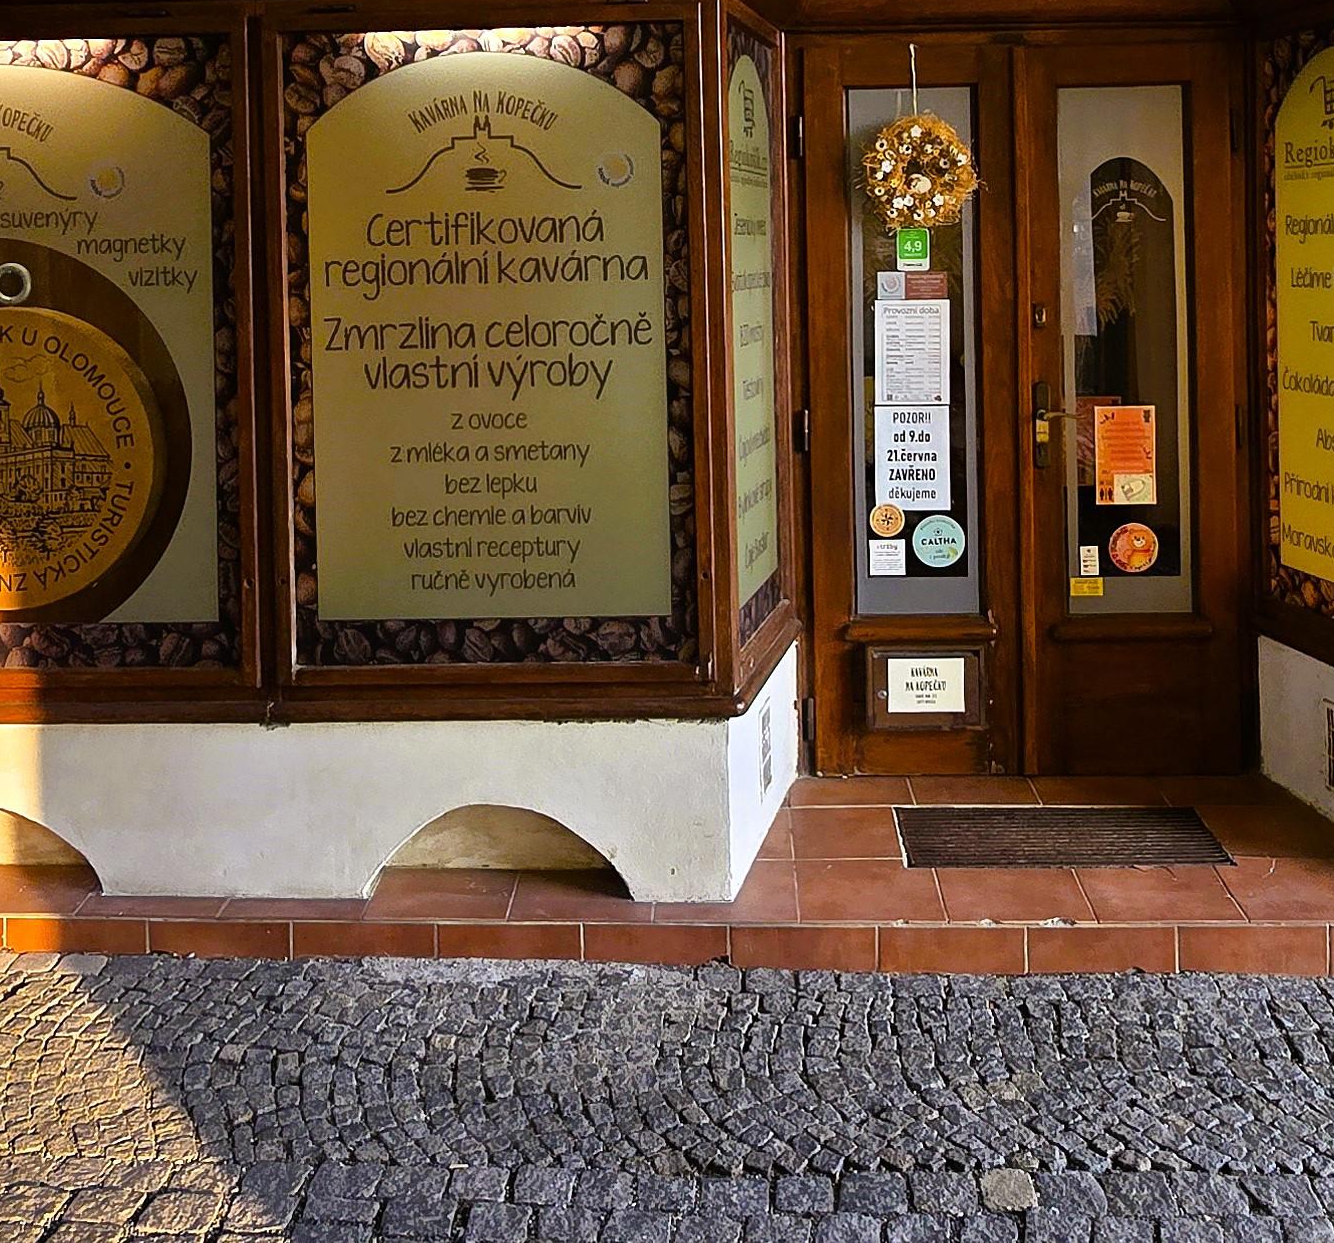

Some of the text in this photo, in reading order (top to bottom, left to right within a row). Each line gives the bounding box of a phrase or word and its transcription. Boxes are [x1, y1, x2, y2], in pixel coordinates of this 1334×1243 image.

[408, 90, 557, 133] KAVÁRNA NA KOPEČKU
[0, 209, 98, 234] suvenýry
[367, 209, 604, 246] Certifikovaná
[77, 234, 186, 261] magnetky
[904, 241, 922, 253] 4,9
[128, 266, 198, 293] vizitky
[324, 250, 649, 301] regionální kavárna
[1291, 267, 1332, 289] Léčíme
[324, 312, 652, 351] Zmrzlina celoročně
[22, 327, 38, 346] U
[43, 336, 135, 449] OLOMOUCE
[364, 352, 613, 400] vlastní výroby
[451, 412, 528, 429] z ovoce
[892, 412, 931, 424] POZOR!!
[894, 430, 906, 443] od
[390, 440, 590, 467] z mléka a smetany
[886, 449, 937, 462] 21.června
[444, 472, 537, 499] bez lepku
[888, 465, 936, 481] ZAVŘENO
[888, 487, 937, 502] děkujeme
[1284, 471, 1330, 503] Přírodní
[391, 504, 591, 527] bez chemie a barviv
[33, 480, 135, 591] TURISTICKÁ
[921, 537, 956, 545] CALTHA
[403, 536, 581, 563] vlastní receptury
[411, 568, 576, 597] ručně vyrobená
